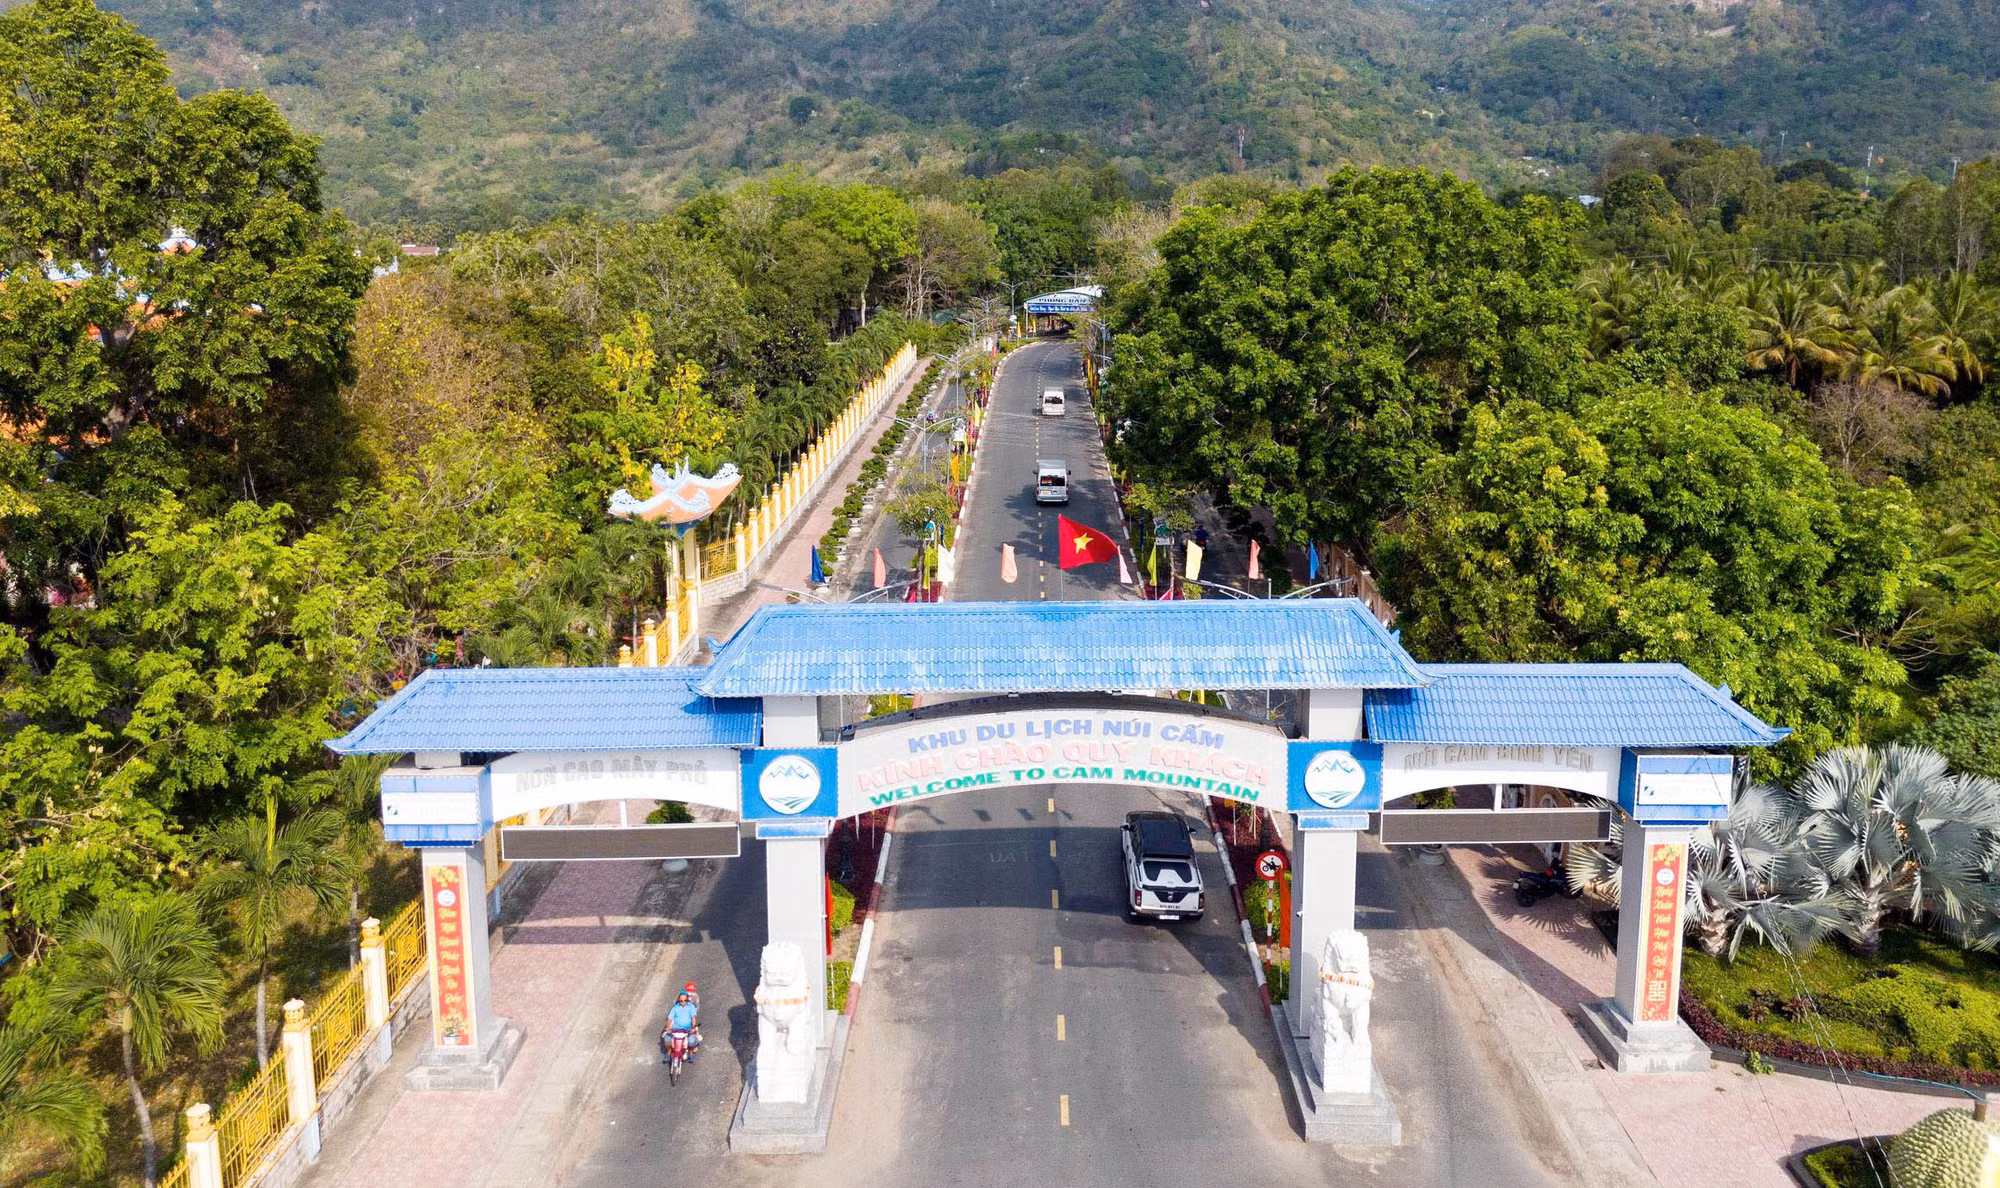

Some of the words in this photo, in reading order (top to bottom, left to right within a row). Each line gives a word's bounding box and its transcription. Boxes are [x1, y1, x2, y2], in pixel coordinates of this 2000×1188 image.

[908, 728, 967, 753] KHU
[976, 722, 1015, 741] DU
[1026, 719, 1092, 739] LỊCH
[1103, 718, 1151, 737] NÚI
[1160, 723, 1225, 749] CẤM
[563, 759, 604, 782] CAO
[611, 755, 657, 779] MÂY
[858, 754, 944, 792] KÍNH
[955, 741, 1051, 771] CHÀO
[1063, 740, 1137, 764] QUÝ
[1151, 746, 1270, 785] KHÁCH
[869, 772, 1001, 806] WELCOME
[1010, 767, 1045, 781] TO
[1053, 766, 1113, 780] CAM
[1124, 768, 1260, 801] MOUNTAIN
